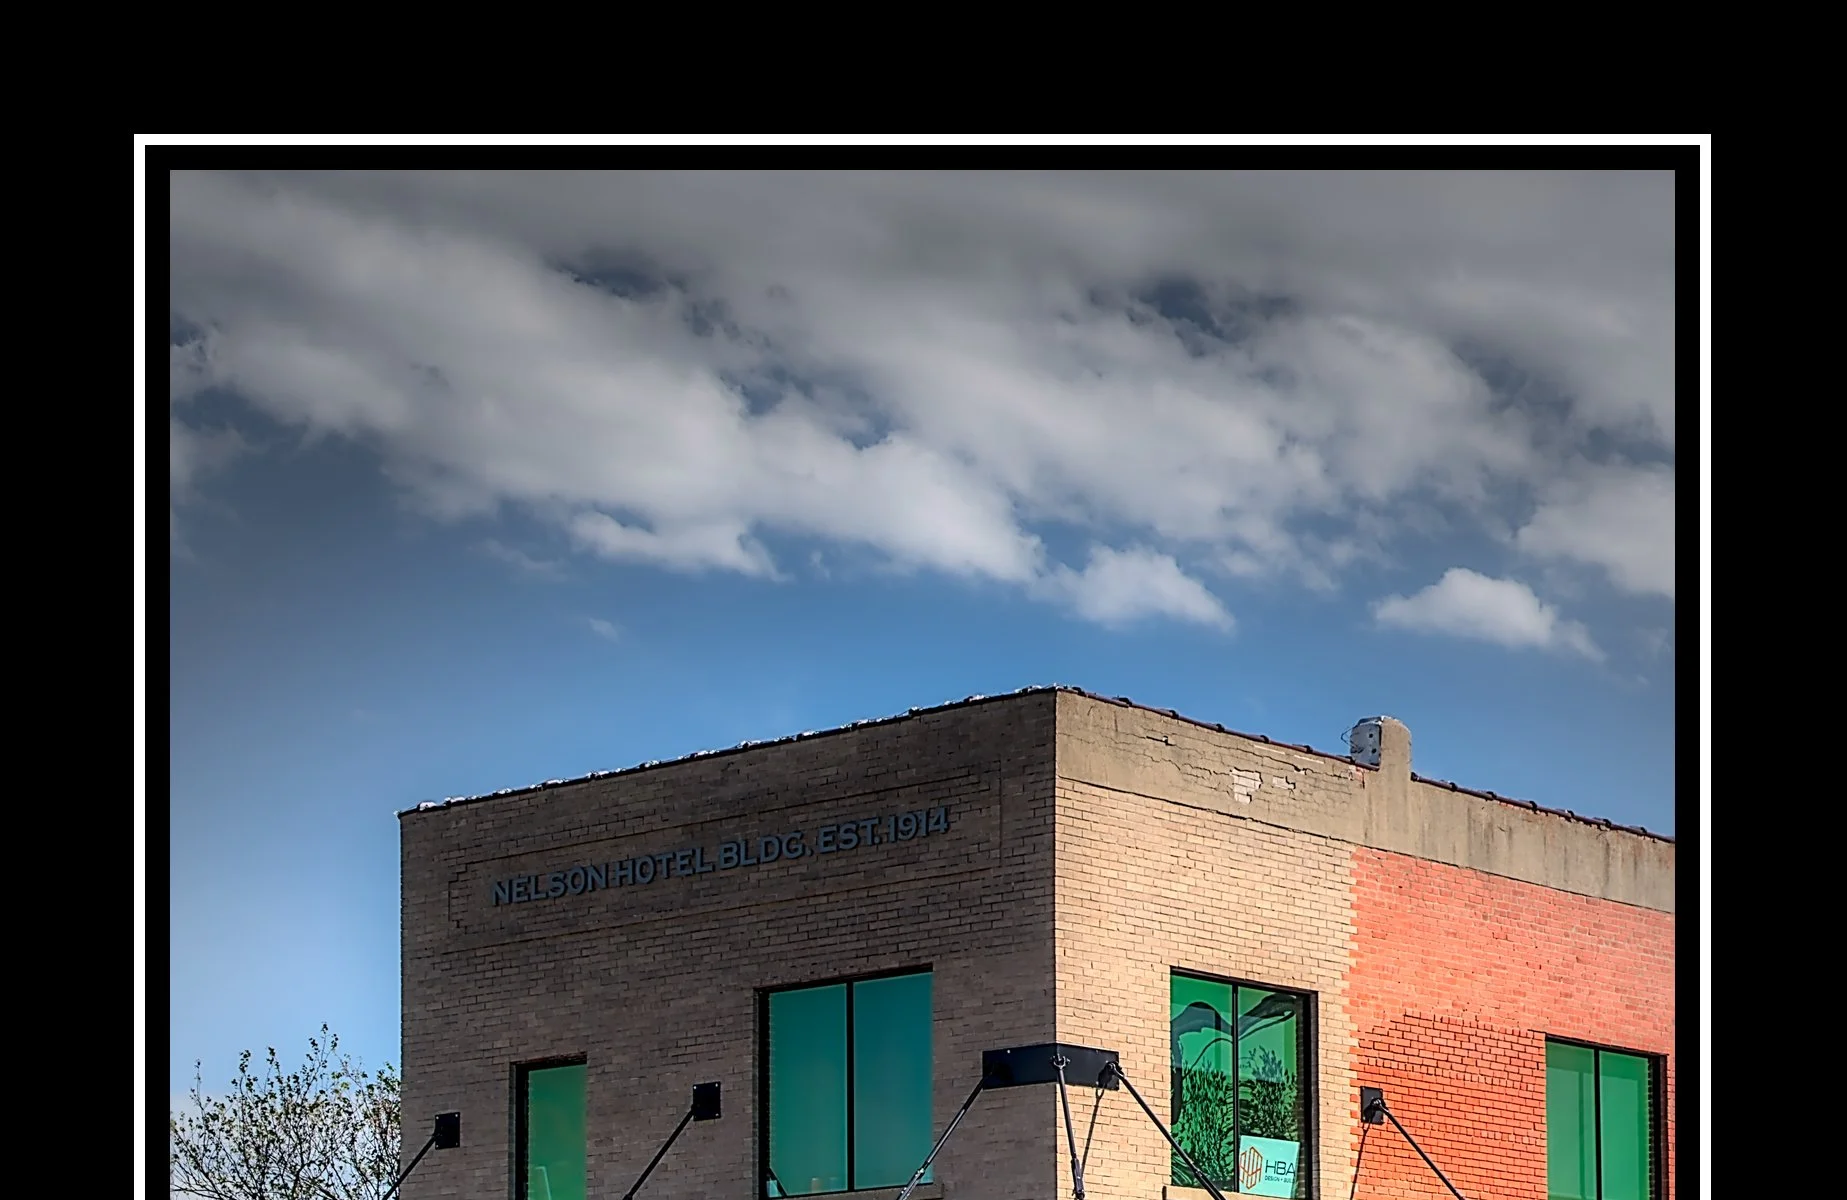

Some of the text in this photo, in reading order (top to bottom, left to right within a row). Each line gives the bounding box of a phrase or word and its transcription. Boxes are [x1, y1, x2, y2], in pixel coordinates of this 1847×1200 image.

[492, 863, 607, 905] NELSON
[614, 847, 714, 885] HOTEL
[816, 816, 882, 854] EST.
[886, 806, 948, 844] 1914
[1264, 1159, 1296, 1177] HBA
